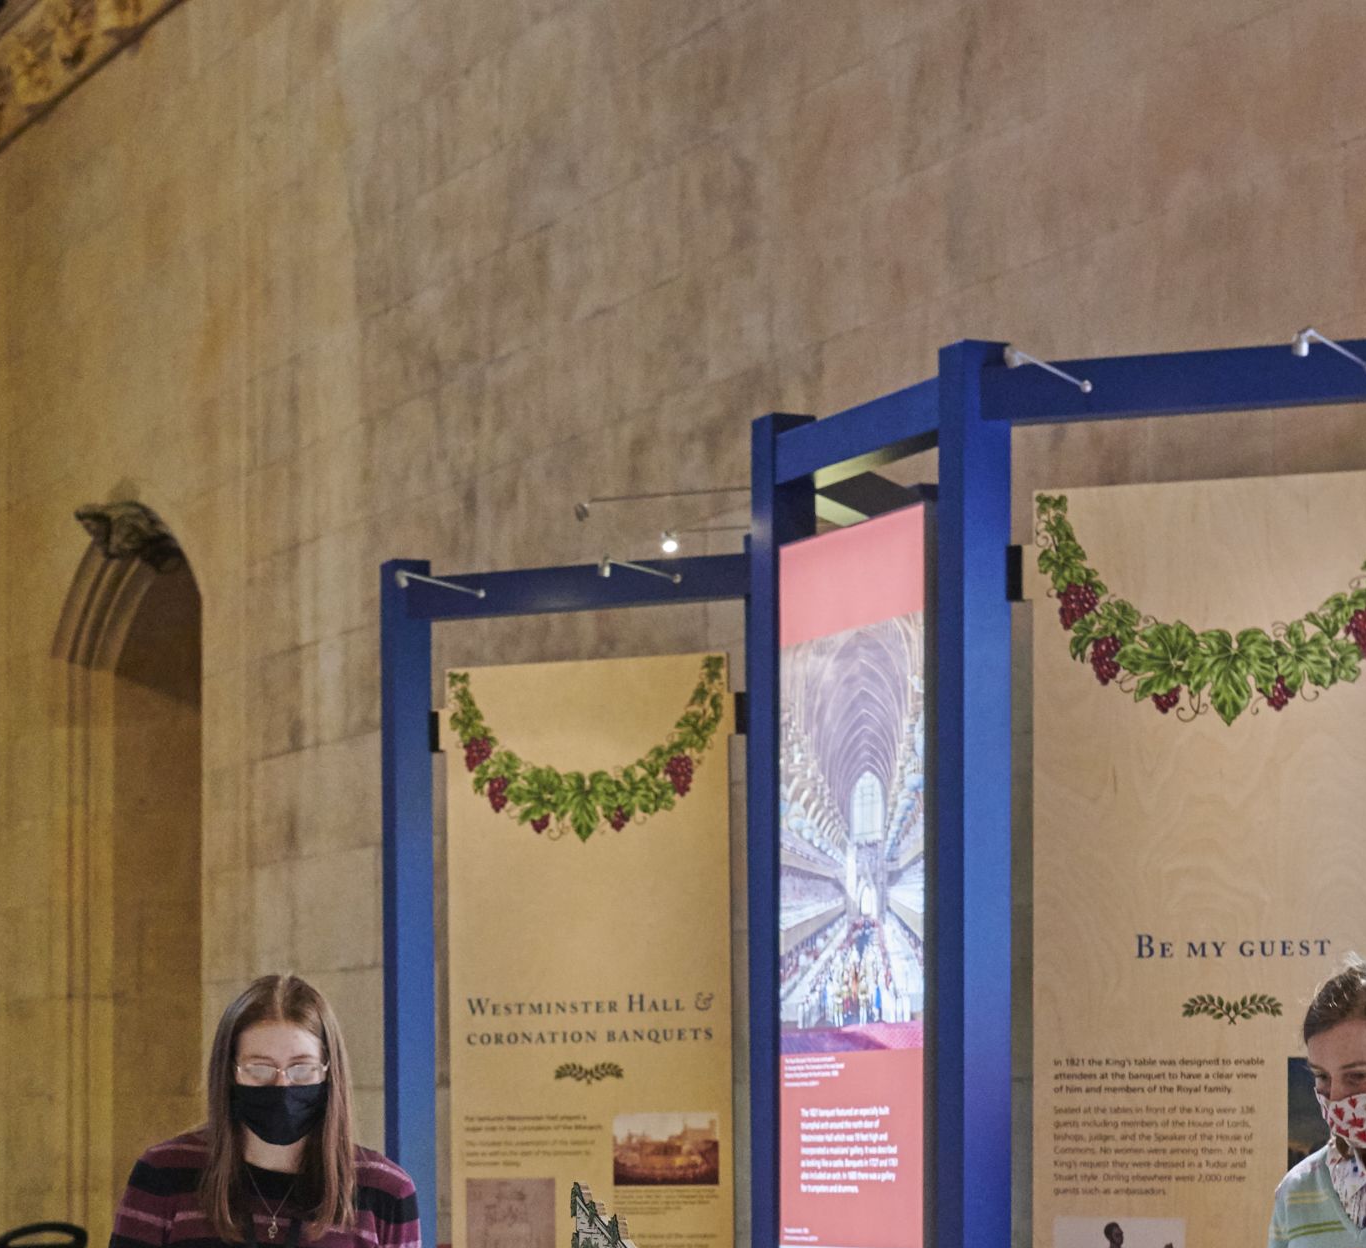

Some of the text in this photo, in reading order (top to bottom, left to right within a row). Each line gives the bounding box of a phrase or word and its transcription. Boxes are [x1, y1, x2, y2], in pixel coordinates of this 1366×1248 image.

[1136, 934, 1330, 958] BE MY GUEST
[467, 992, 714, 1016] WESTMINSTER HALL &
[467, 1027, 713, 1045] CORONATION BANQUETS
[1179, 1059, 1219, 1067] designed
[1054, 1072, 1097, 1080] attendees
[1129, 1072, 1165, 1081] banquet
[1104, 1085, 1144, 1093] members
[1147, 1085, 1157, 1093] of
[1160, 1085, 1174, 1093] the
[1177, 1085, 1201, 1094] Royal
